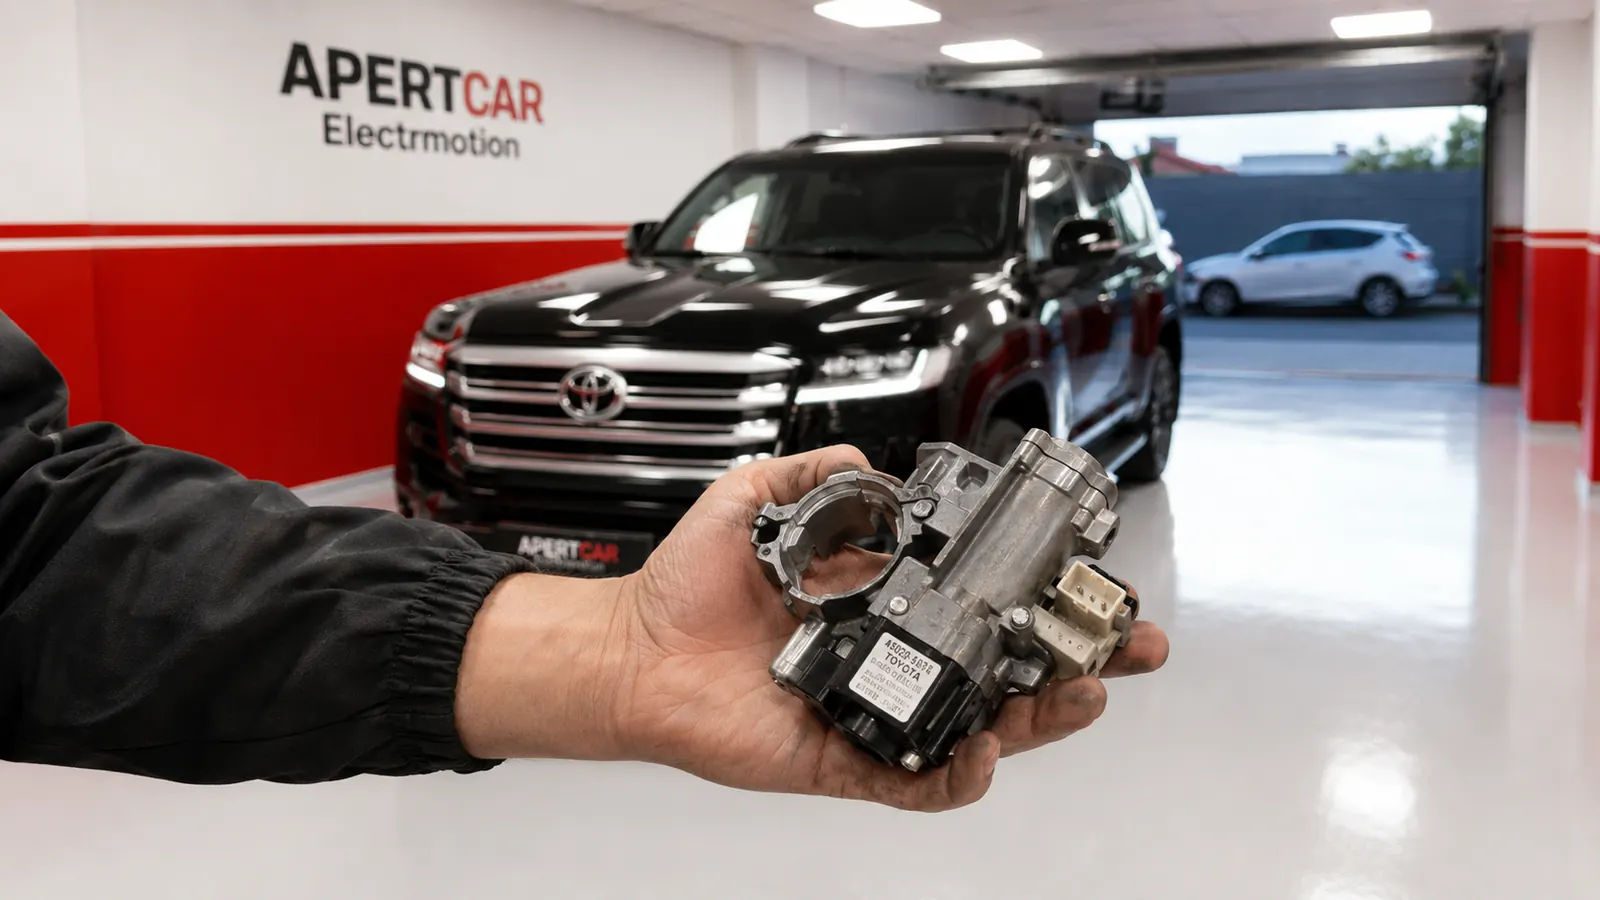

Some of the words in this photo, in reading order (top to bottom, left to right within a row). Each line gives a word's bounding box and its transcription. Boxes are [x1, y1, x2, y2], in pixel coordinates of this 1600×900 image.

[280, 42, 544, 124] APERTCAR
[322, 113, 521, 158] Electrmotion
[517, 535, 620, 564] APERTCAR
[884, 651, 921, 682] TOYOTA
